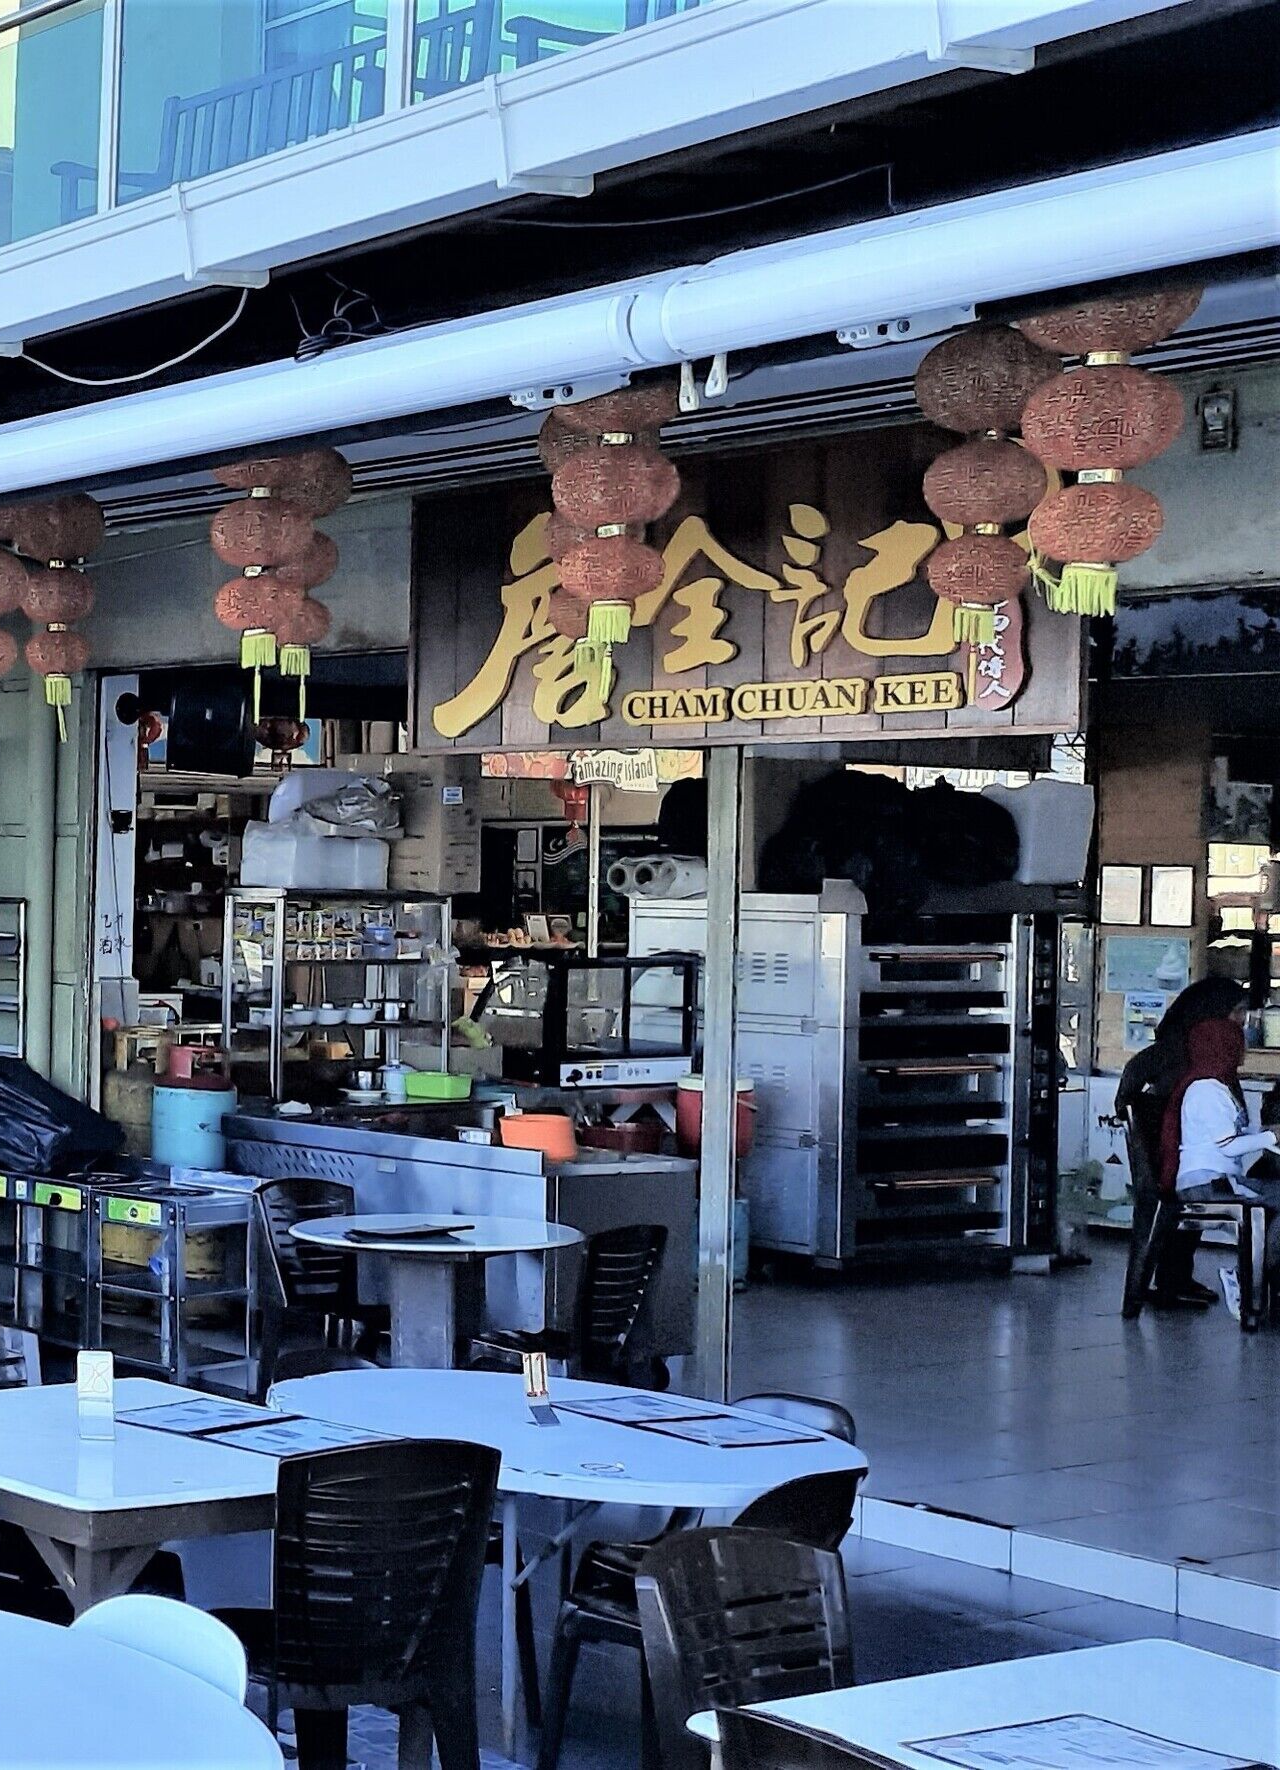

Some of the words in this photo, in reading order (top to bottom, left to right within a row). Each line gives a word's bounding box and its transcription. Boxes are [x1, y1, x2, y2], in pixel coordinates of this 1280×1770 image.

[627, 692, 720, 720] CHAM
[739, 684, 861, 716] CHUAN
[881, 676, 955, 708] KEE
[577, 756, 623, 785] amazing
[624, 753, 654, 782] island
